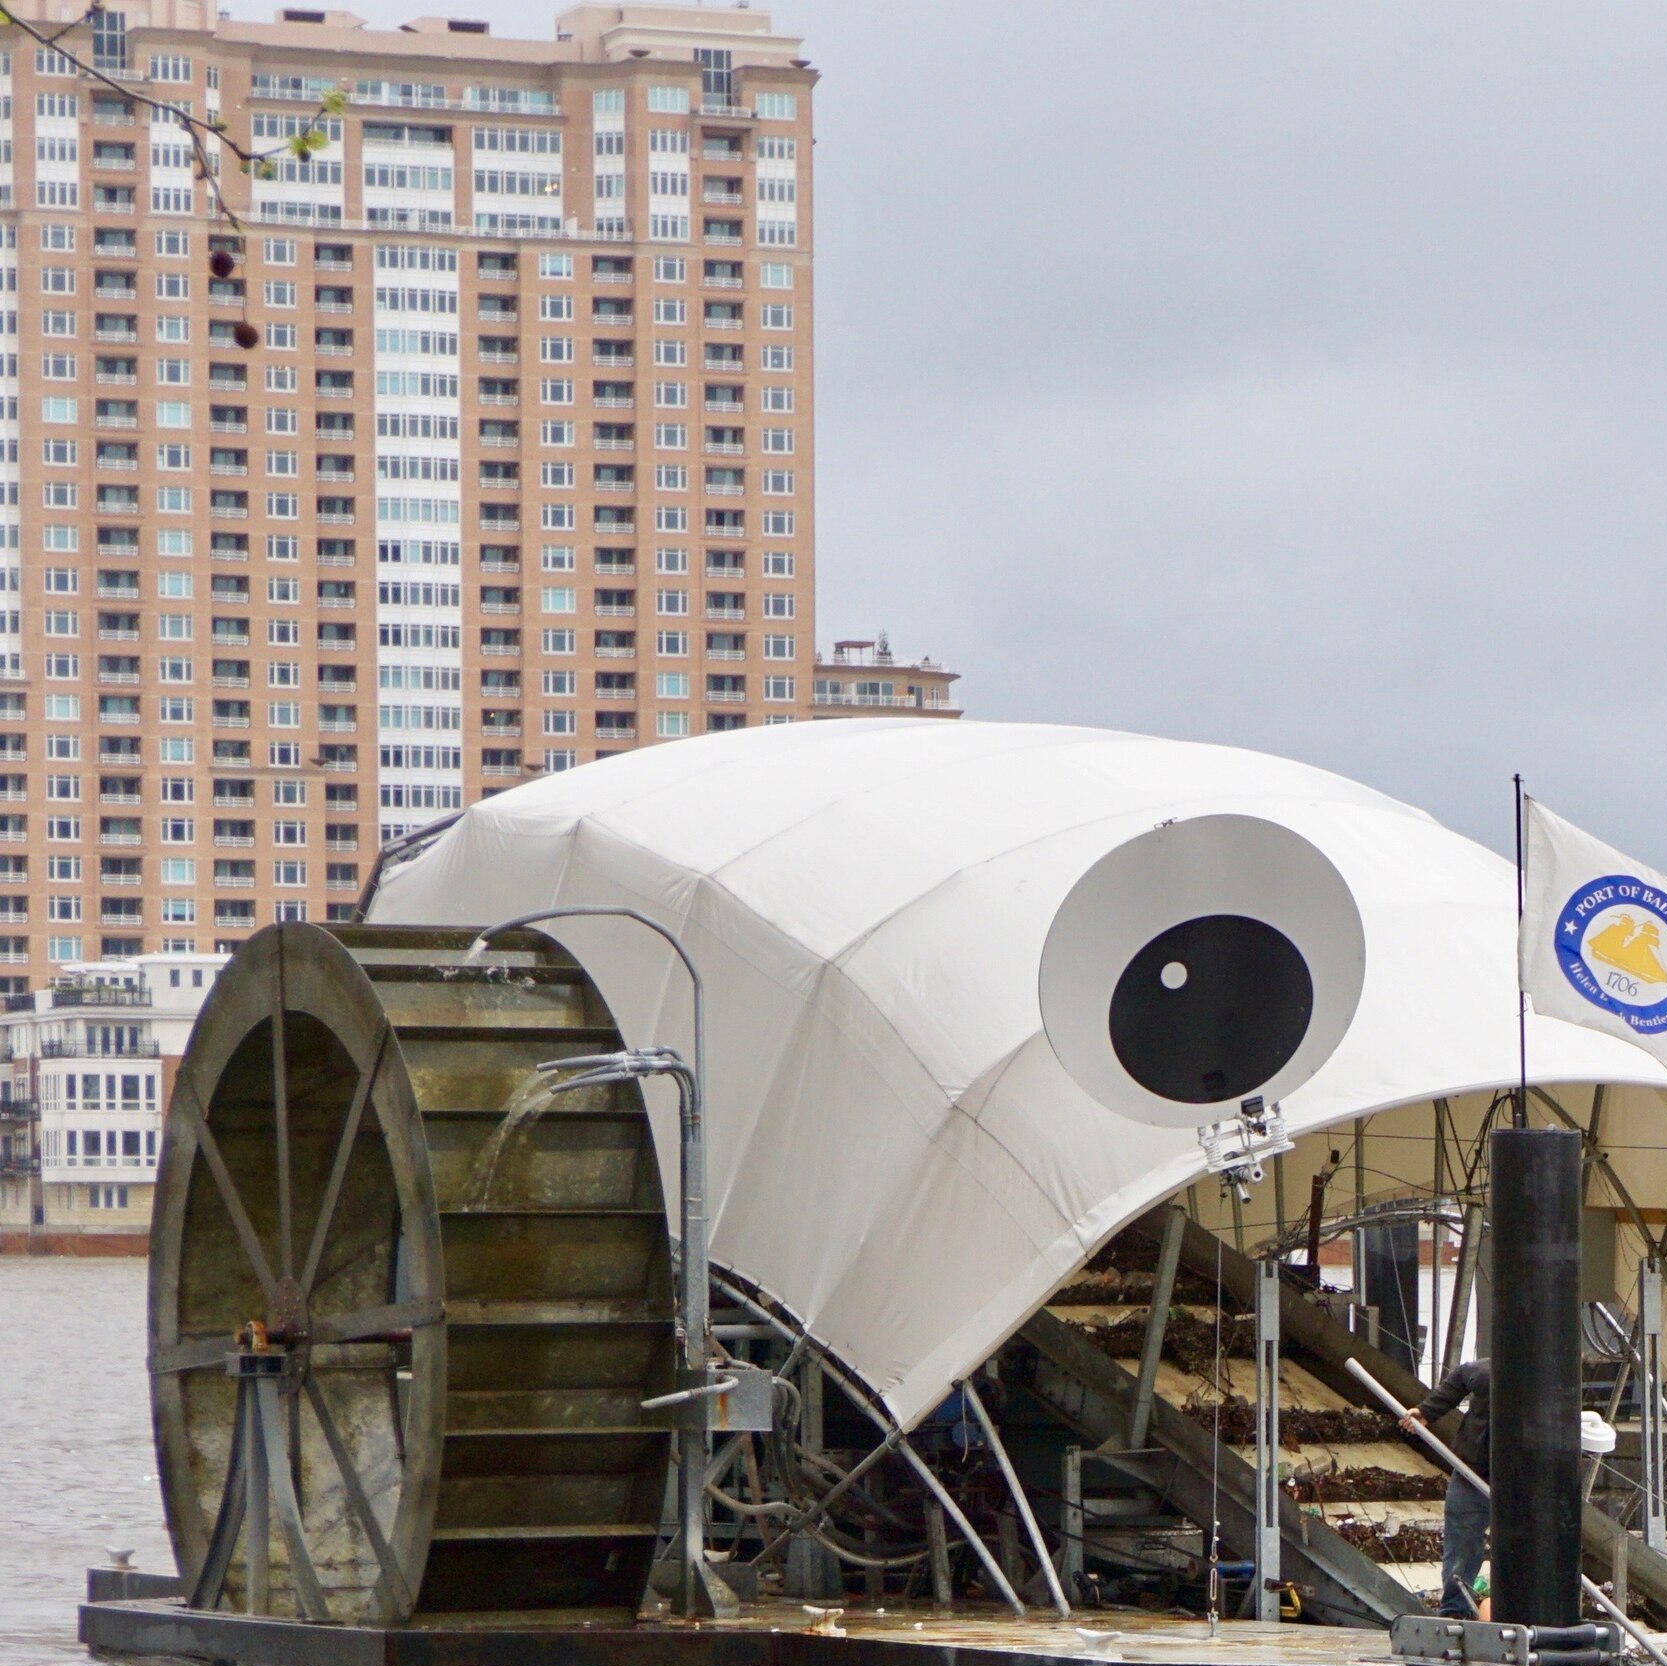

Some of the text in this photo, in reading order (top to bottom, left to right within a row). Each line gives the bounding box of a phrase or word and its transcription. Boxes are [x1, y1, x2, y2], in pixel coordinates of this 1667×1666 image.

[1575, 886, 1614, 917] PORT
[1618, 885, 1640, 898] OF
[1569, 962, 1597, 994] Helen
[1606, 971, 1640, 998] 1706
